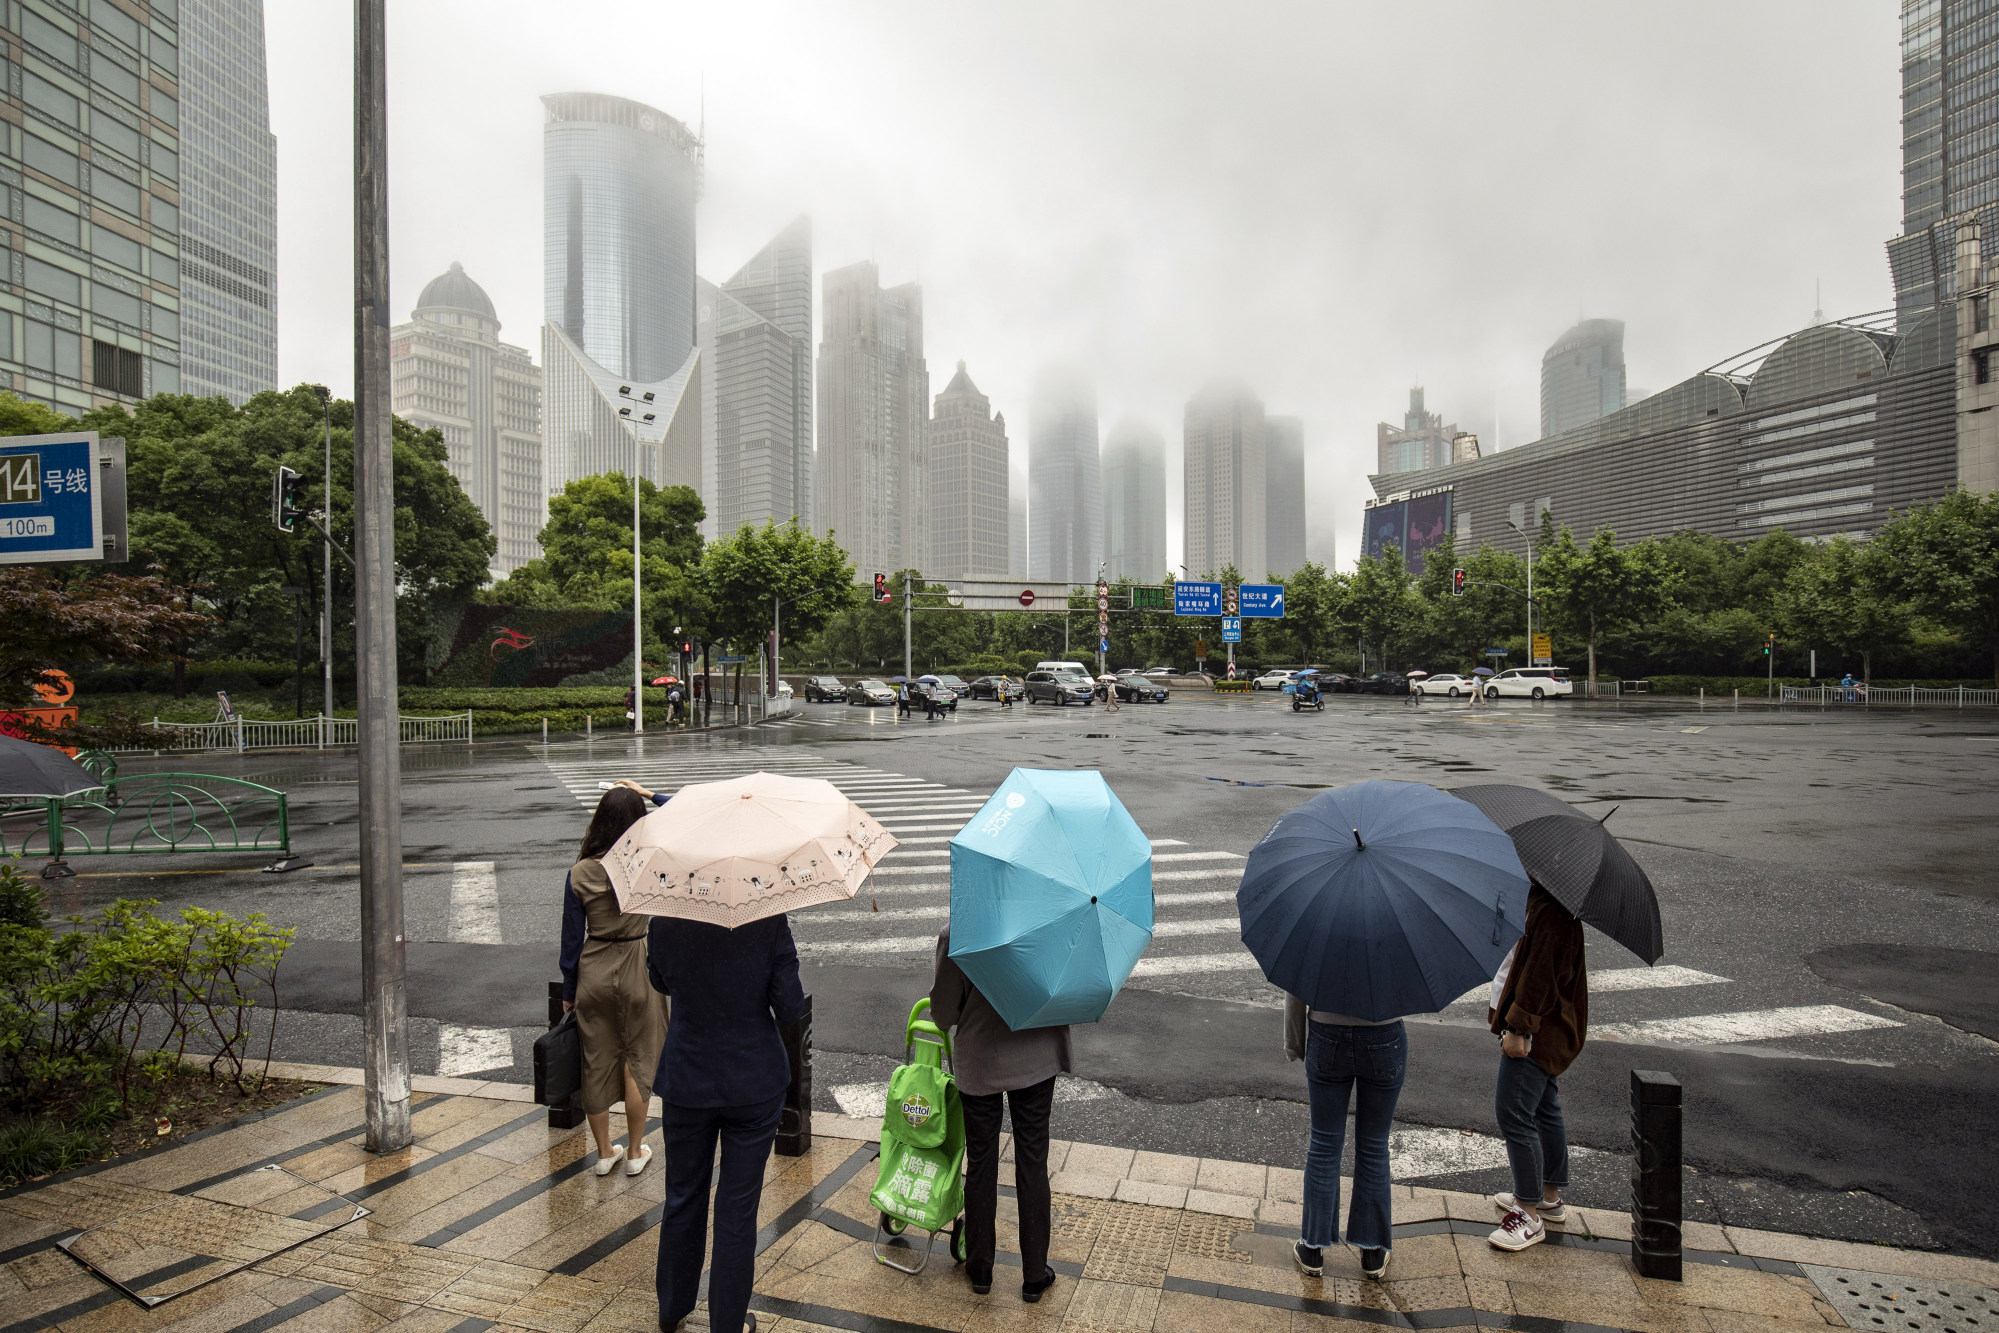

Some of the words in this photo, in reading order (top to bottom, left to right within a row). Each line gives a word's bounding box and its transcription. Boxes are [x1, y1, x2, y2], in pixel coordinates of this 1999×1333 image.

[0, 458, 37, 500] 14
[44, 467, 88, 494] 号线
[6, 519, 47, 536] 100m
[1242, 592, 1267, 600] 世纪大道
[1178, 600, 1210, 608] 陆家嘴环路
[987, 810, 1013, 838] NCIC
[903, 1103, 930, 1116] Dettol
